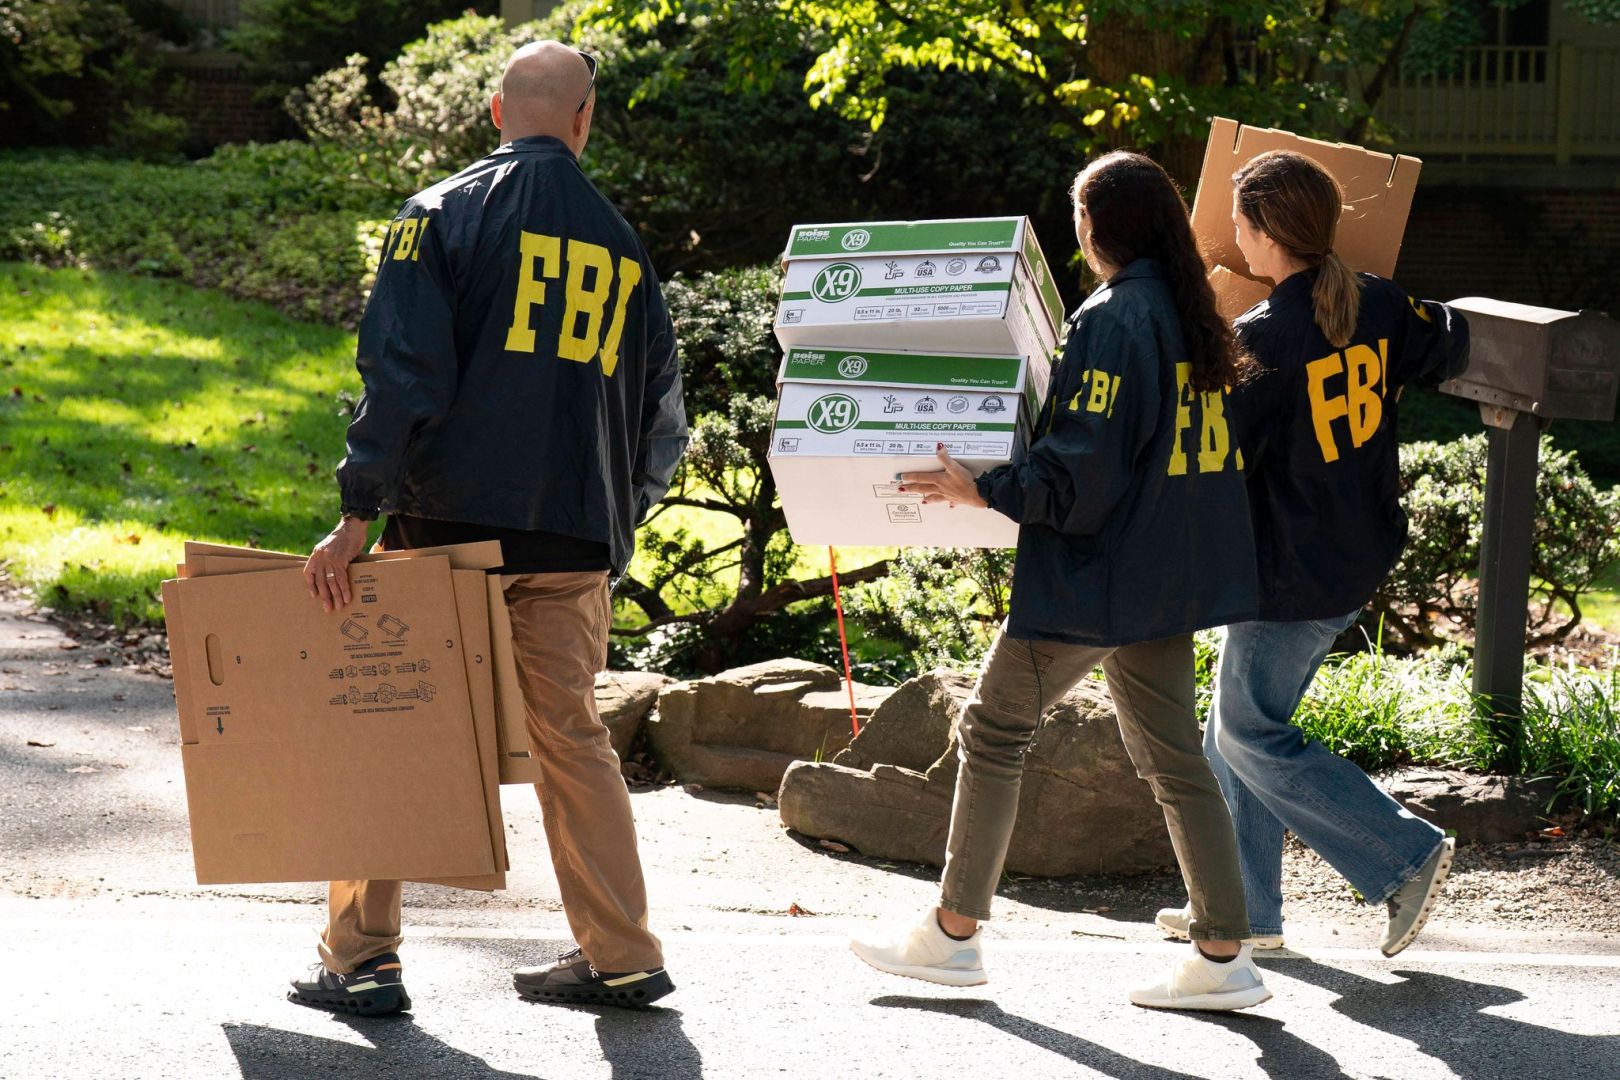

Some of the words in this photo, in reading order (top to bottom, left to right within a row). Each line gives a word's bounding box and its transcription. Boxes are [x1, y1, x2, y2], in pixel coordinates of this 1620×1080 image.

[917, 268, 933, 277] USA
[894, 285, 929, 294] MULTI-USE
[930, 285, 949, 293] COPY
[949, 284, 973, 292] PAPER
[504, 230, 642, 377] FBI
[791, 358, 825, 366] PAPER
[917, 404, 934, 413] USA
[1167, 362, 1245, 476] FB
[895, 422, 932, 430] MULTI-USE
